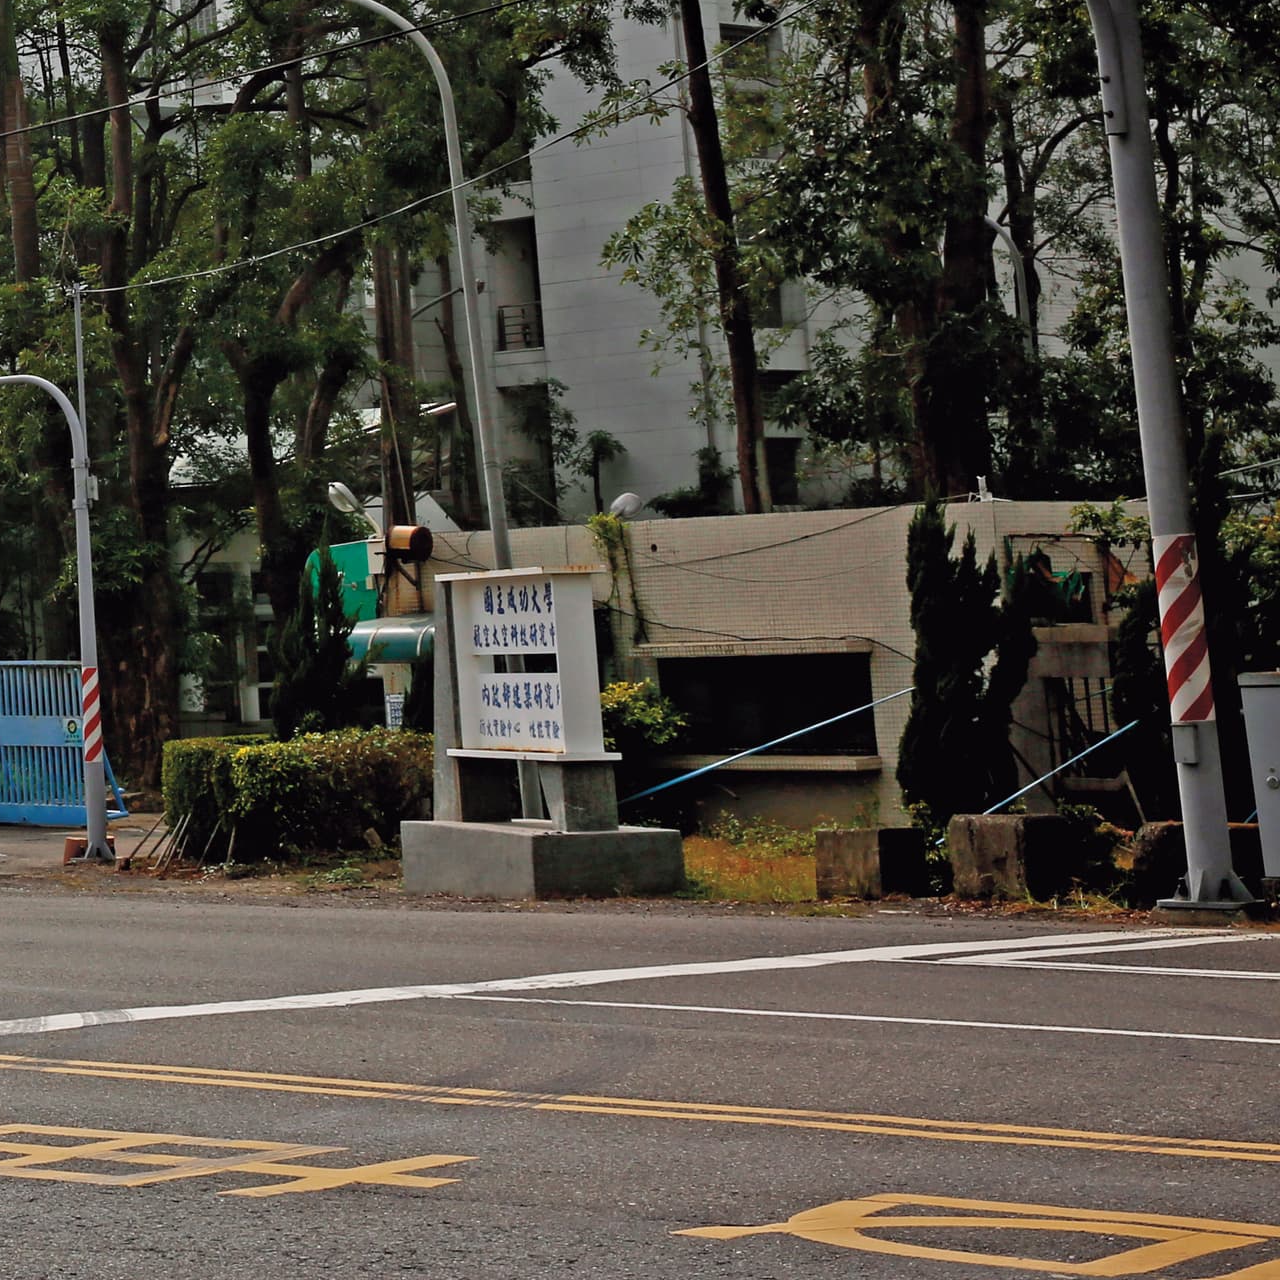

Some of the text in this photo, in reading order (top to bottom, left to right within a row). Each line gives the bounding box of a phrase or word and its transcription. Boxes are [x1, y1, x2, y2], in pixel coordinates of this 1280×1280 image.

[484, 582, 553, 615] 國立成功大學
[482, 682, 560, 710] 內政部建築研究
